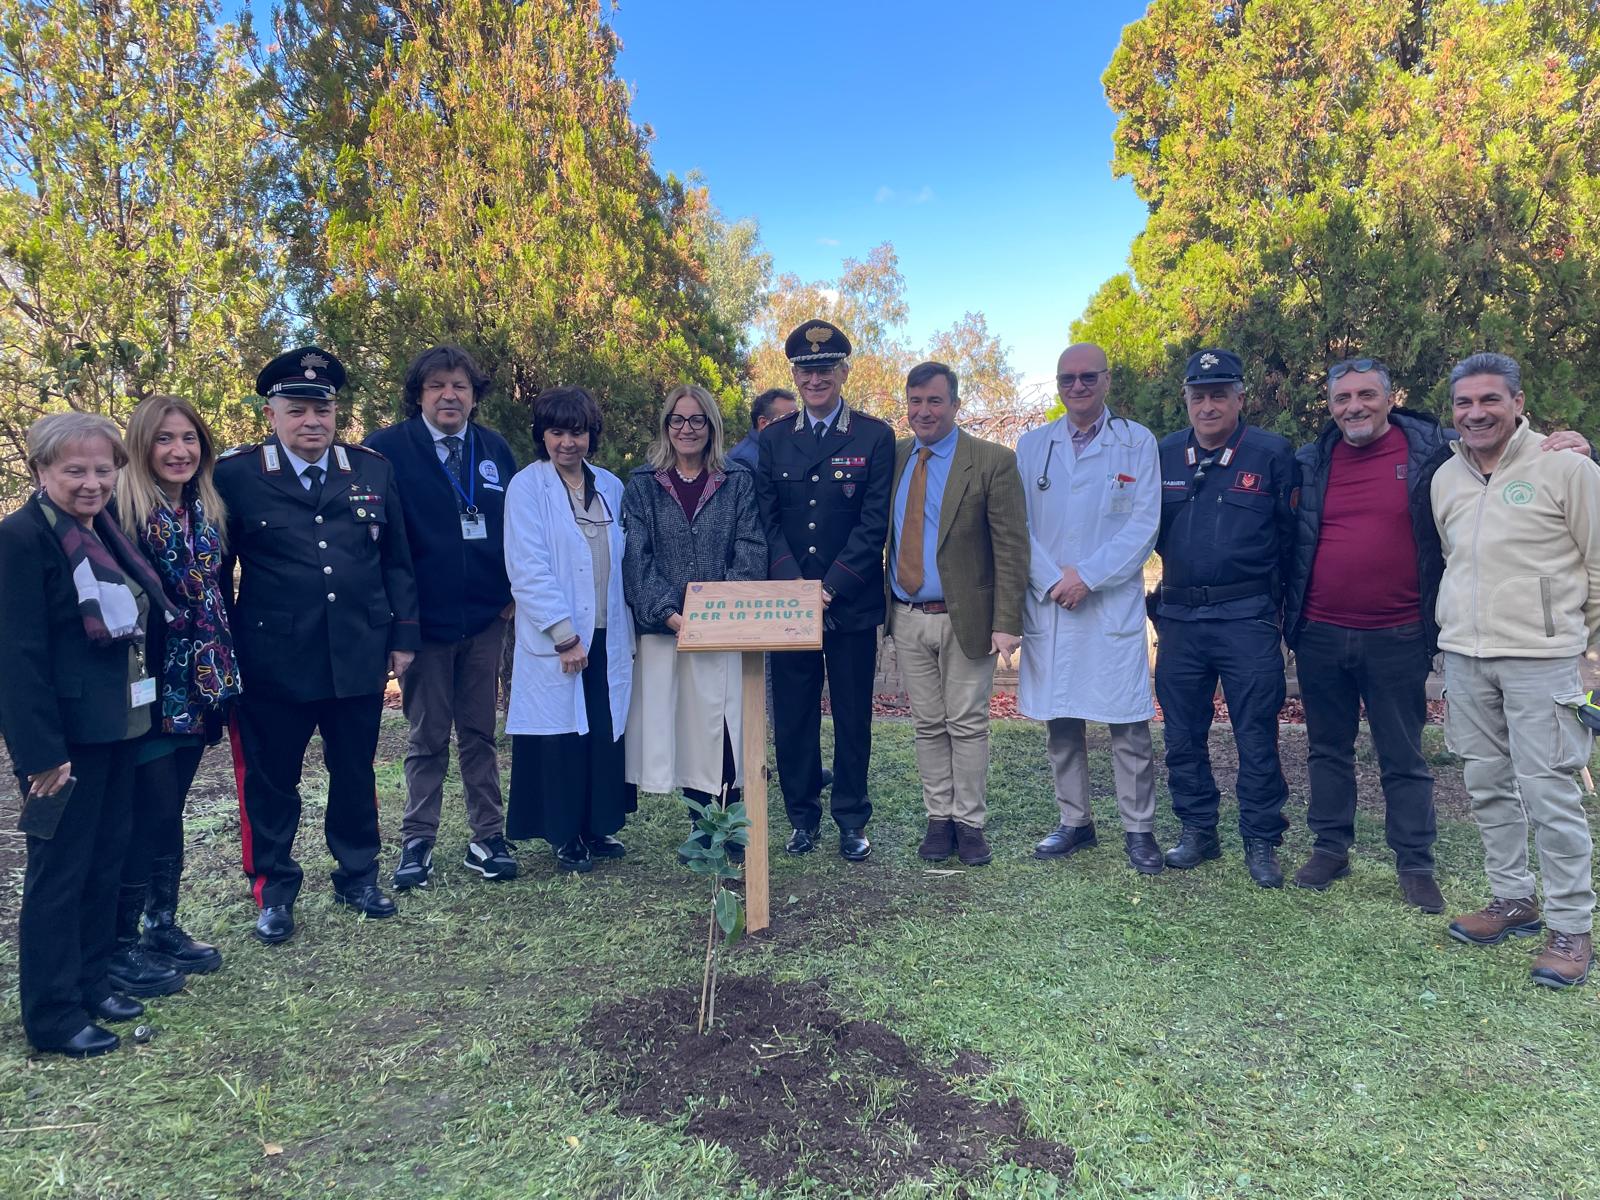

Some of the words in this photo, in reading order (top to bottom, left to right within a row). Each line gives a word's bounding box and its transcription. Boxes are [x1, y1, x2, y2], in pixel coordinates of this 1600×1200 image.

[705, 600, 726, 609] UN
[735, 599, 799, 609] ALBERO
[689, 612, 721, 620] PER
[729, 611, 746, 620] LA
[754, 610, 814, 620] SALUTE
